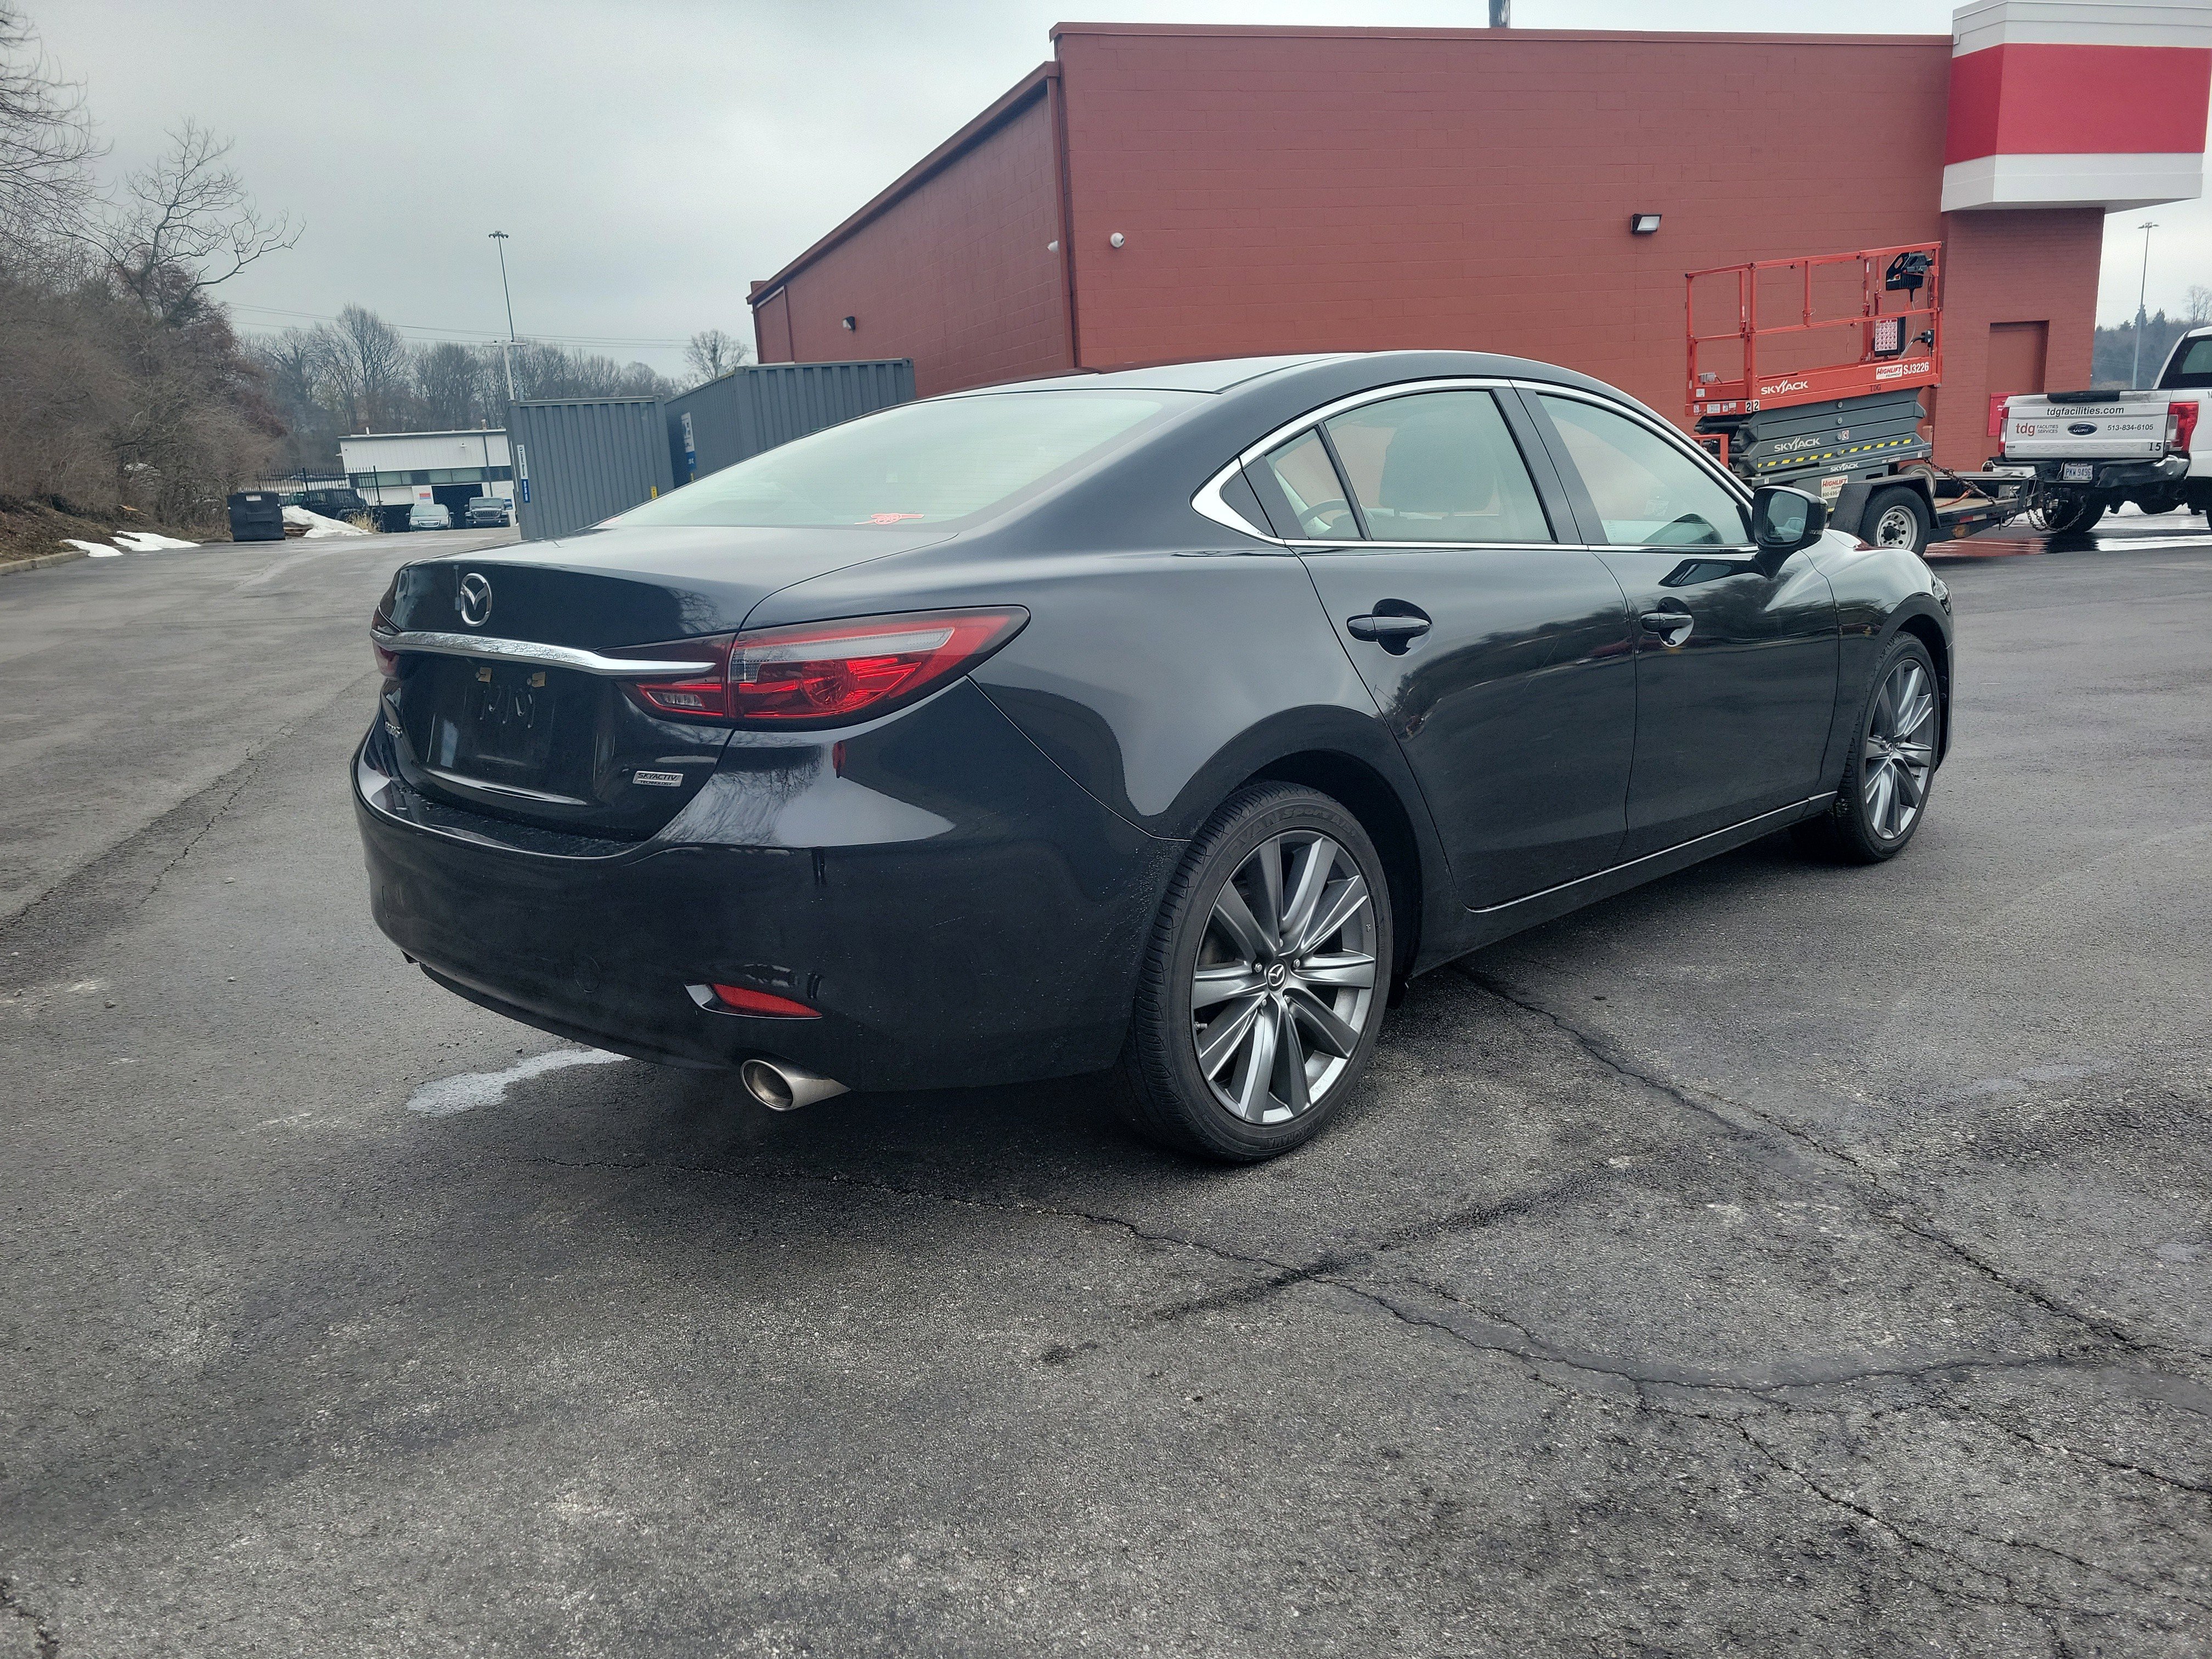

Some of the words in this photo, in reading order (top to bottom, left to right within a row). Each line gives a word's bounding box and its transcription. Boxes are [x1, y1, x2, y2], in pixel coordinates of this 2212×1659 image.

[1877, 366, 1901, 375] HIGHLIFT
[1903, 362, 1929, 375] SJ3226
[1761, 379, 1809, 395] SKYJACK
[2047, 407, 2124, 417] tdgfacilities.com
[2016, 423, 2036, 436] tdg
[1774, 436, 1820, 452] SKYJACK
[2149, 442, 2162, 451] 15
[1830, 462, 1859, 472] SKYJACK
[1822, 478, 1847, 487] HIGHLIFT
